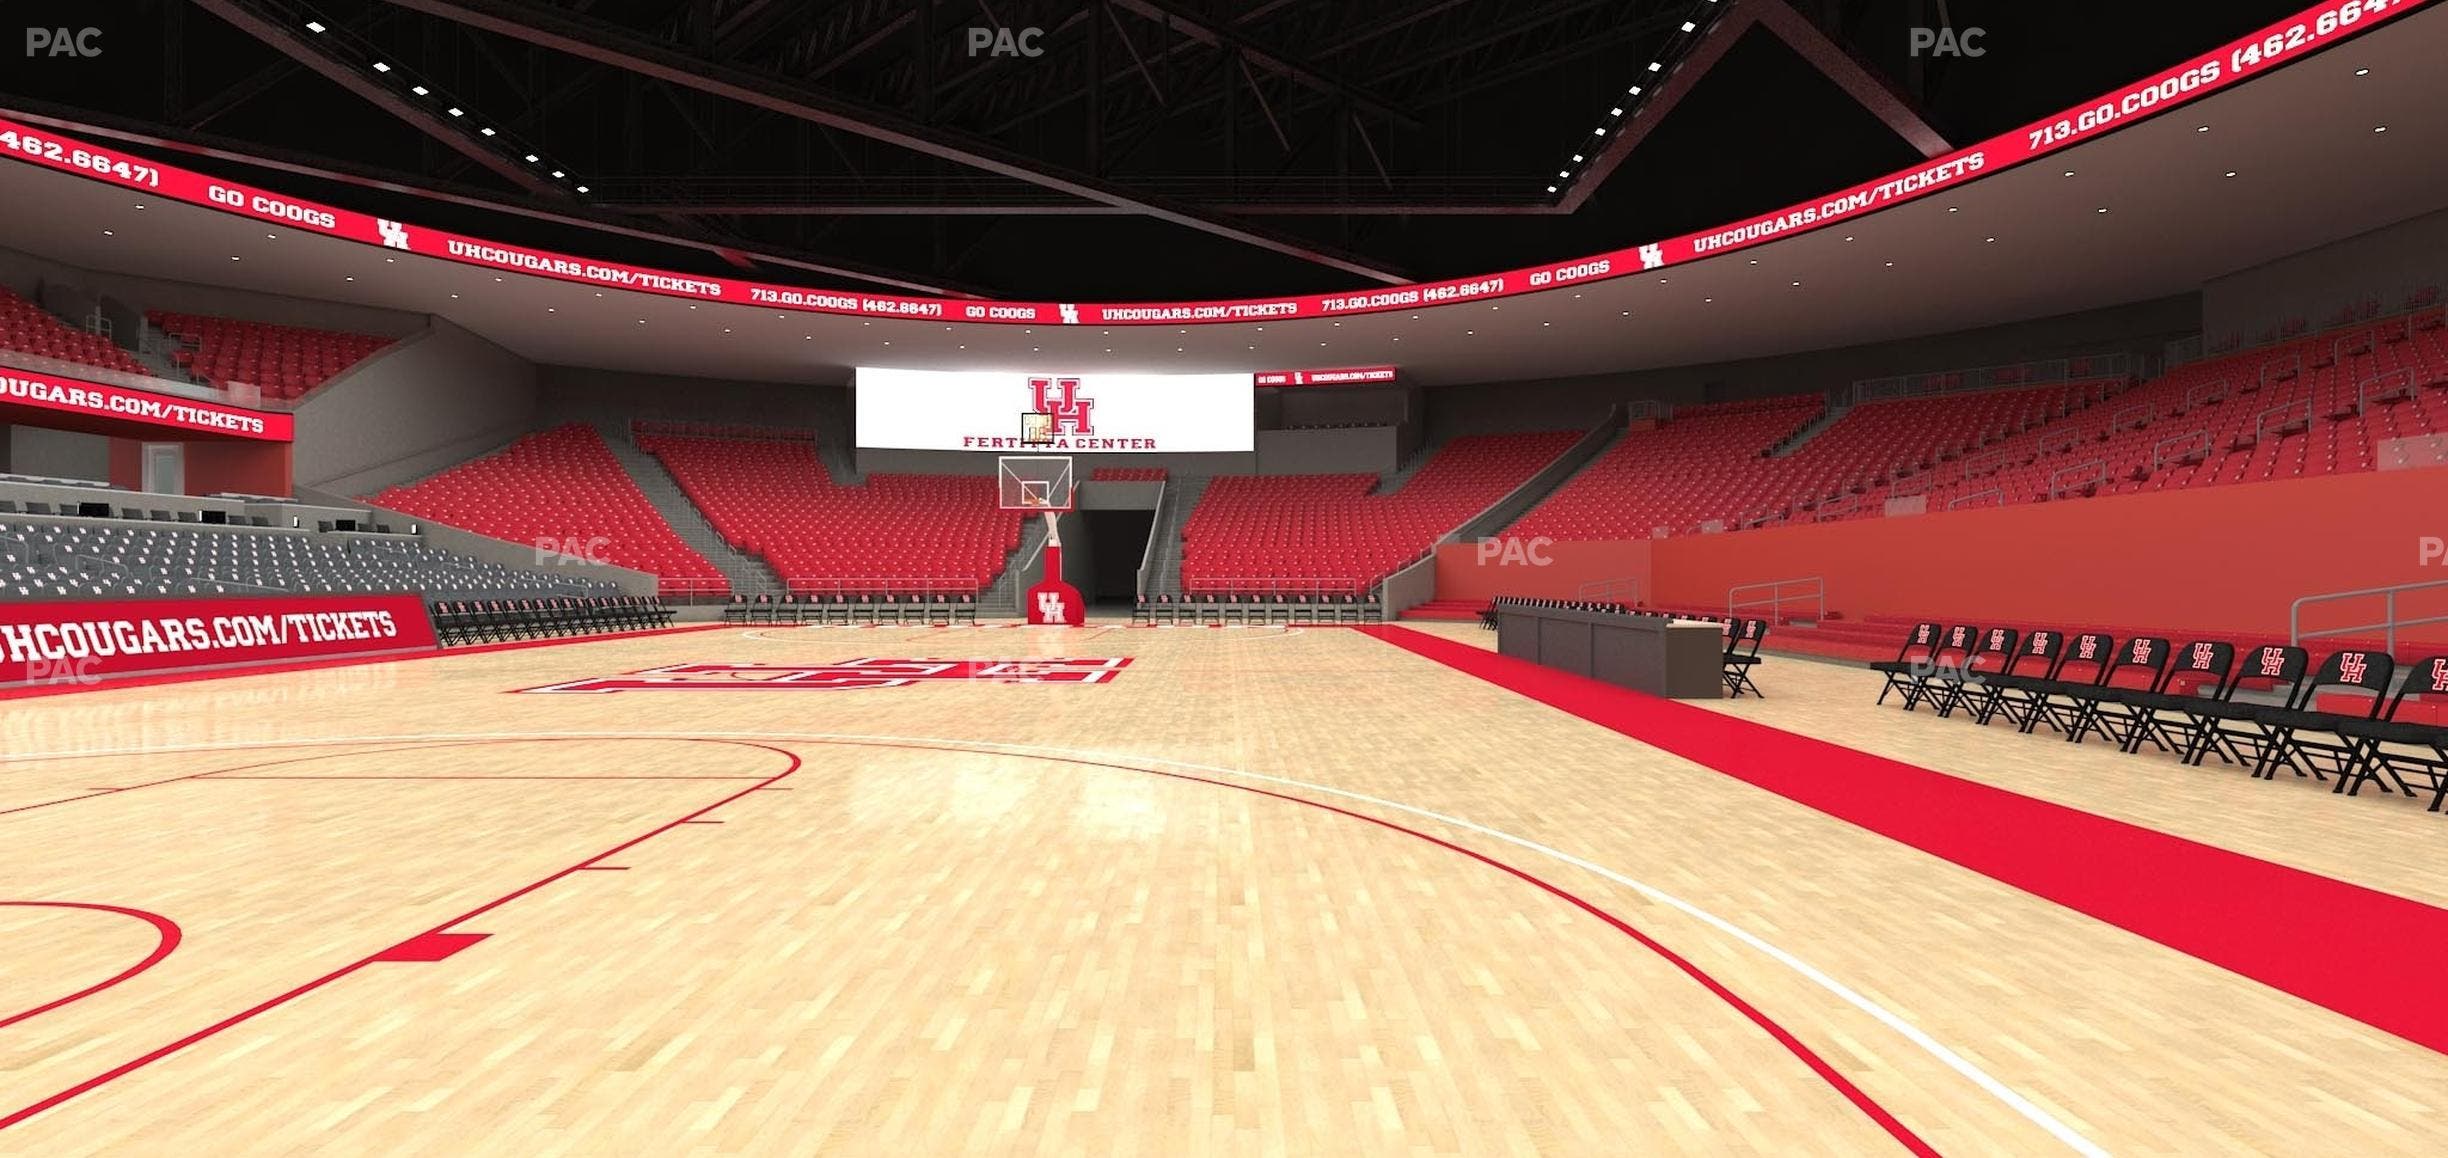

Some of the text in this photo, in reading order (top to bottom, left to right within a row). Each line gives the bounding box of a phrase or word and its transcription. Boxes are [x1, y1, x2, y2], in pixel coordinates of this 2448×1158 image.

[2029, 61, 2221, 149] 713.GO.COOGS
[208, 185, 336, 229] GO COOGS
[1693, 152, 1985, 252] UHCOUGARS.COM/TICKETS
[448, 240, 722, 296] UHCOUGARS.COM/TICKETS
[1530, 260, 1610, 286] GO COOGS
[751, 288, 857, 310] 713.GO.COOGS
[965, 306, 1036, 320] GO COOGS
[1102, 302, 1298, 321] UHCOUGARS.COM/TICKETS
[1321, 290, 1419, 312] 713.GO.COOGS
[1028, 377, 1095, 436] UH
[1075, 438, 1157, 449] CENTER
[0, 610, 398, 664] HCOUGARS.COM/TICKETS
[2192, 642, 2214, 670] UH
[2261, 647, 2285, 676] UH
[2339, 652, 2367, 684] UH
